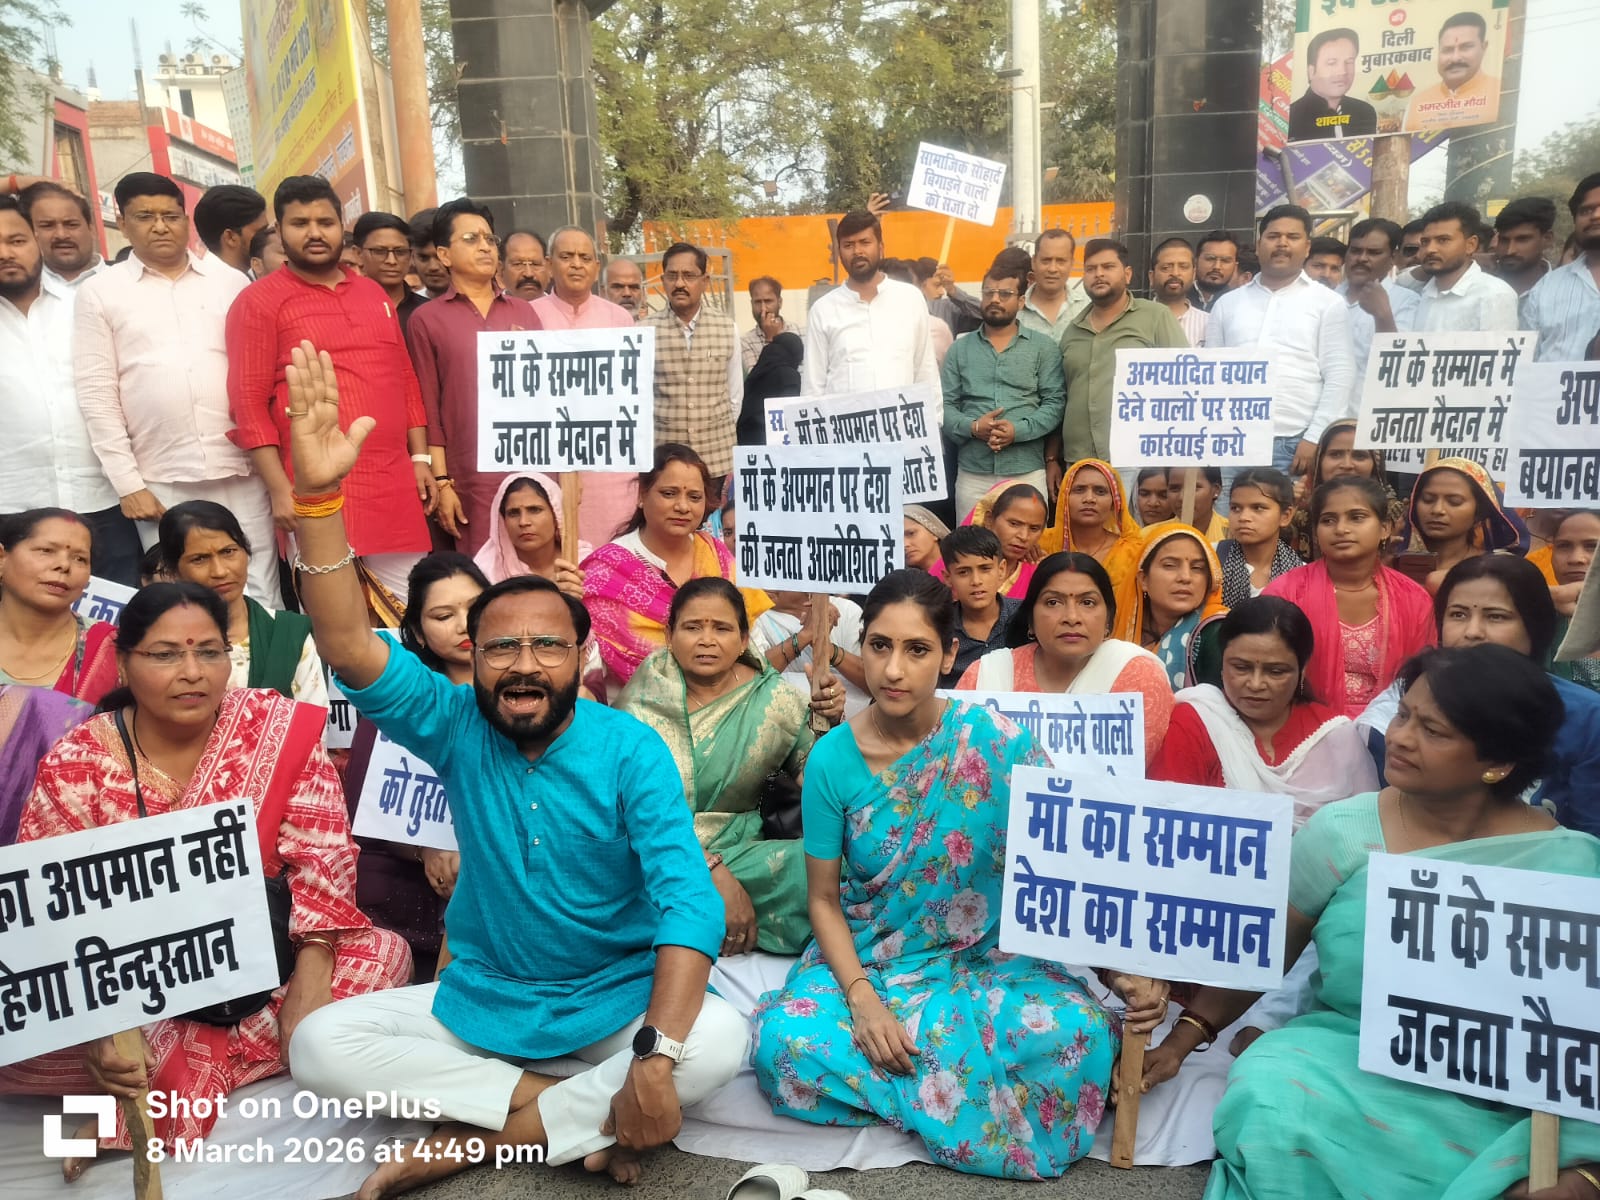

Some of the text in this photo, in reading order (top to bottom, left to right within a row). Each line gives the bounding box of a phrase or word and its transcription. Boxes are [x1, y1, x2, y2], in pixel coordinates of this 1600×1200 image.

[1361, 46, 1434, 74] मुबारकबाद
[1381, 28, 1416, 48] दिली
[920, 150, 970, 175] सामाजिक
[922, 167, 963, 196] बिगाड़ने
[925, 189, 941, 209] को
[967, 201, 980, 219] दो
[490, 334, 643, 397] माँ के सम्मान में
[1127, 354, 1269, 386] अमर्यादित बयान
[1378, 337, 1526, 388] माँ के सम्मान में
[794, 393, 927, 444] माँ के अपमान पर देश
[1117, 390, 1273, 422] देने वालों पर सख्त
[1370, 394, 1512, 443] जनता मैदान में
[1556, 370, 1600, 425] अप
[493, 405, 639, 465] जनता मैदान में
[1139, 426, 1246, 460] कार्रवाई करो
[740, 454, 758, 511] माँ
[761, 454, 776, 512] के
[781, 467, 835, 512] अपमान
[838, 467, 860, 514] पर
[863, 452, 891, 514] देश
[1519, 449, 1600, 500] बयानब
[740, 521, 895, 584] की जनता आक्रोशित है
[1047, 700, 1086, 754] करने
[1090, 699, 1135, 755] वालों
[379, 757, 412, 817] को
[1026, 777, 1272, 880] माँ का सम्मान
[41, 837, 180, 922] अपमान
[181, 805, 250, 885] नहीं
[1014, 855, 1275, 968] देश का सम्मान
[1388, 869, 1600, 989] माँ के सम्म
[0, 917, 239, 1036] हेगा हिन्दुस्तान
[1387, 993, 1600, 1110] जनता मैद
